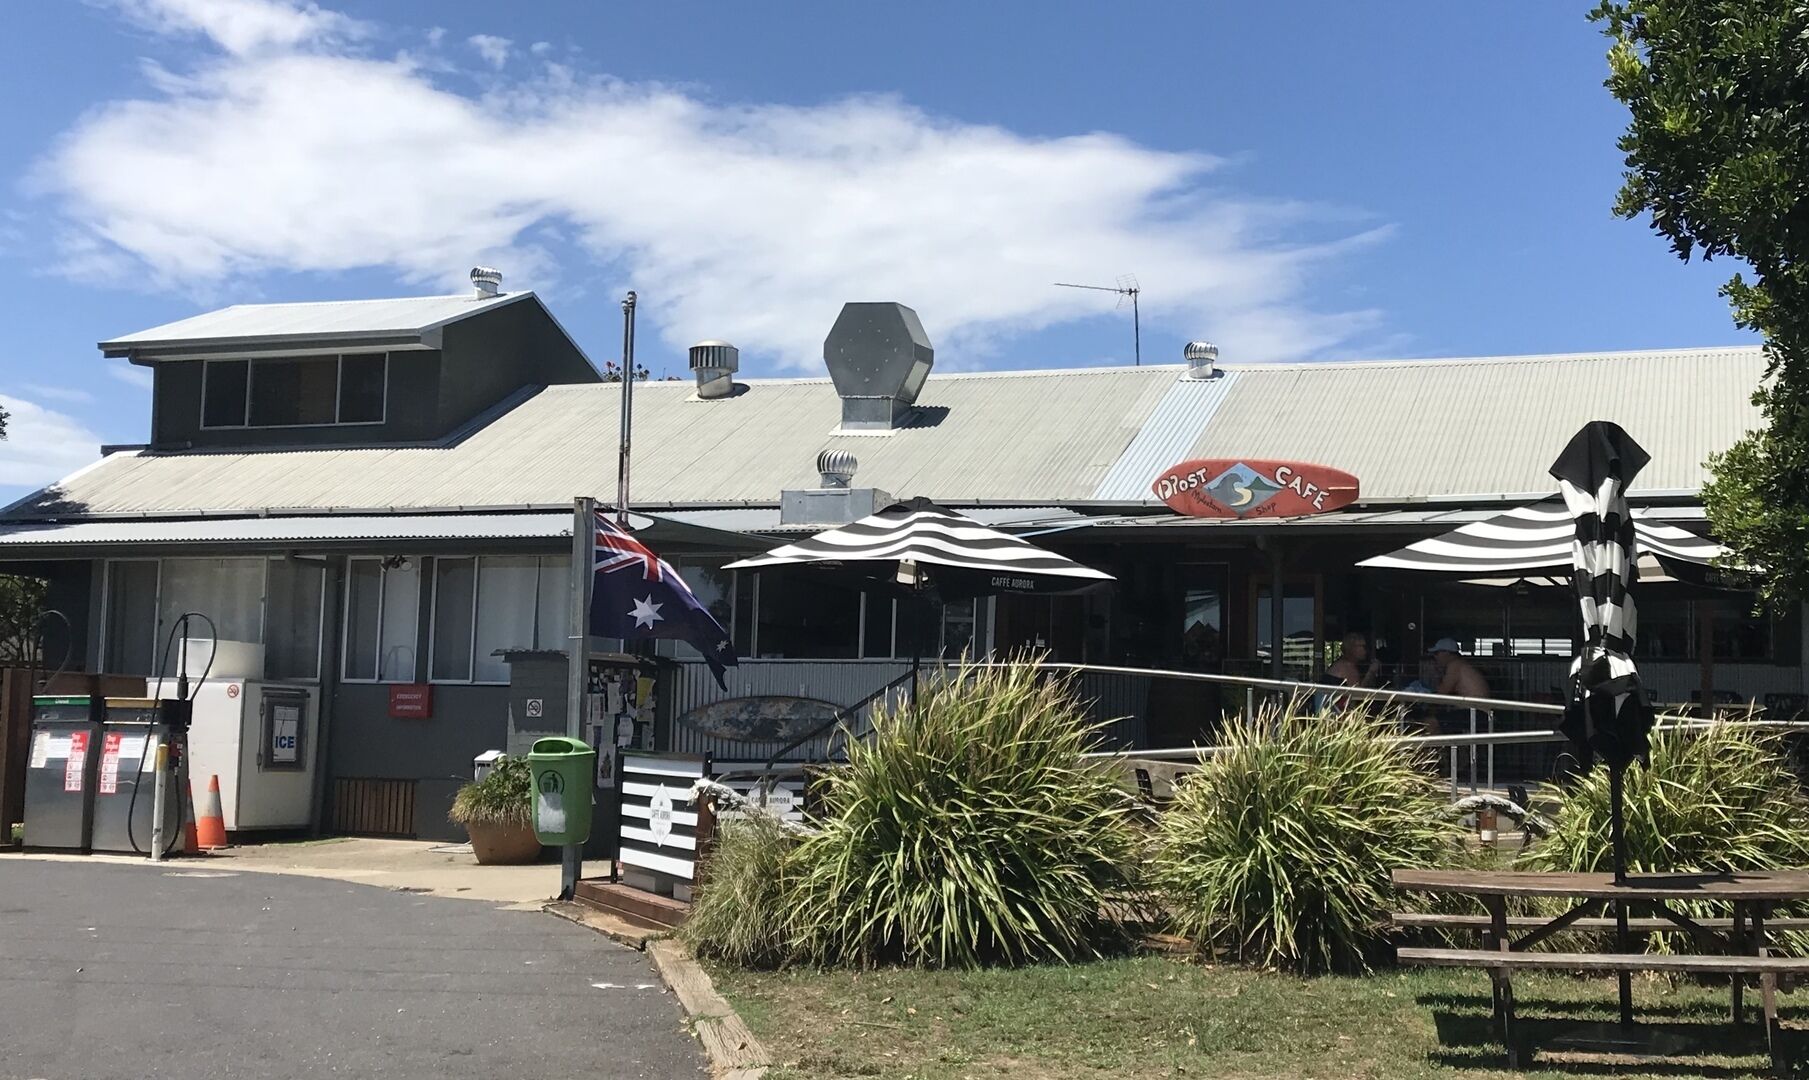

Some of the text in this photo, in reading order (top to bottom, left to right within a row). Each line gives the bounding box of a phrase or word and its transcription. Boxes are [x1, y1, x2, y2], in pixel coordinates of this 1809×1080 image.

[1275, 465, 1330, 511] CAFE
[1011, 578, 1034, 590] AURORA
[273, 735, 295, 749] ICE
